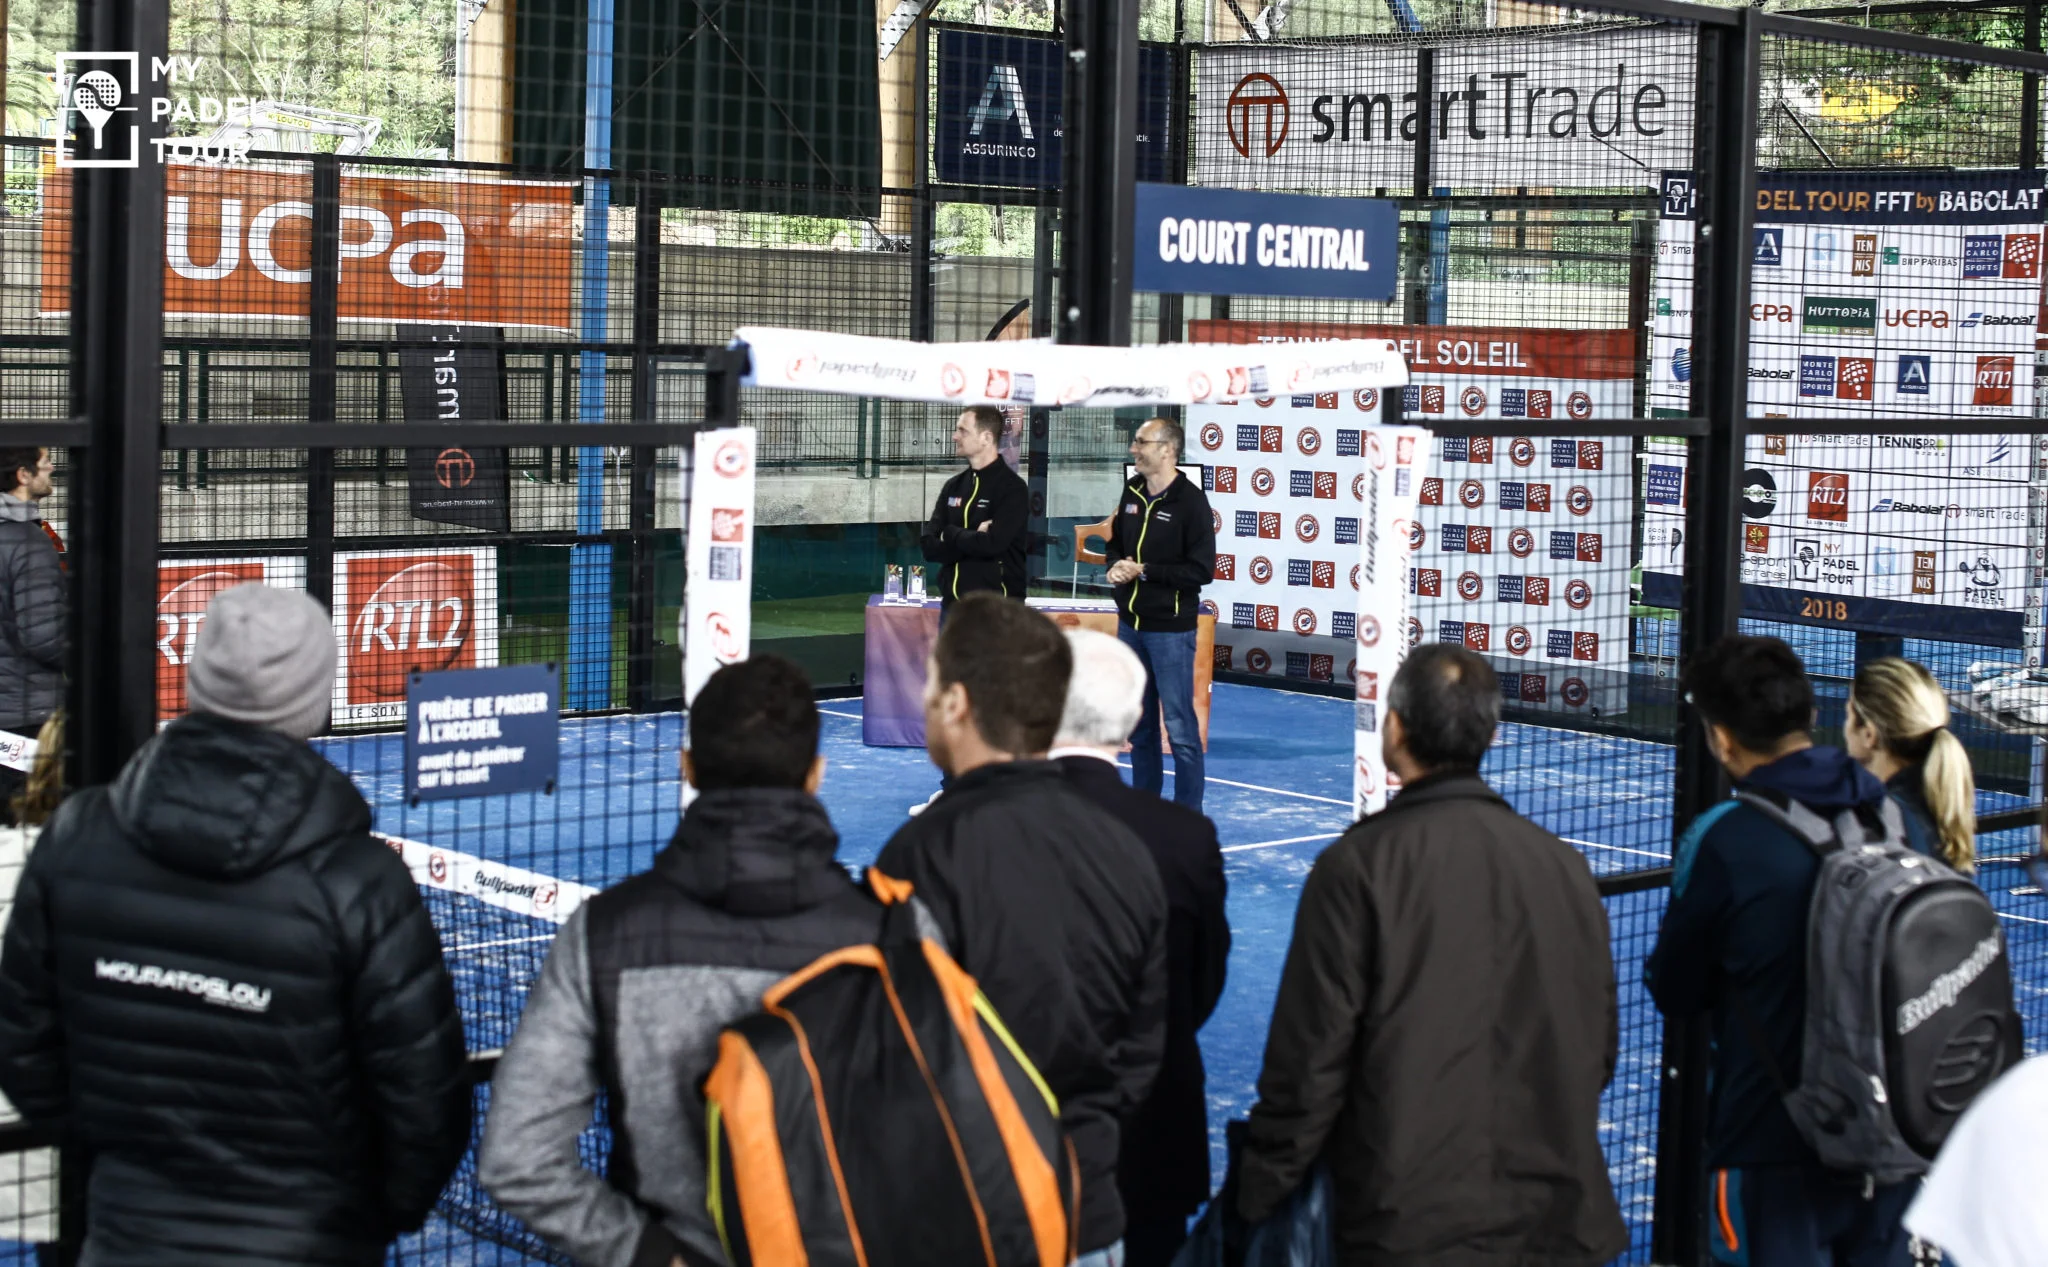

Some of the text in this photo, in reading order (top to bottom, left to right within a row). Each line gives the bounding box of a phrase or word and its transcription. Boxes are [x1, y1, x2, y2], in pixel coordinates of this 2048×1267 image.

[963, 143, 1036, 158] ASSURINCO
[1756, 189, 2043, 213] DEL TOUR FFT by BABOLAT
[1159, 217, 1370, 271] COURT CENTRAL
[1856, 240, 1873, 252] TEN
[1854, 259, 1871, 272] NIS
[1922, 258, 1958, 266] PARIBAS
[1436, 340, 1527, 367] SOLEIL
[1802, 361, 1833, 369] MONTE
[1801, 383, 1832, 391] SPORTS
[1650, 478, 1680, 486] CARLO
[1812, 486, 1845, 505] RTL2
[1822, 558, 1860, 572] PADEL
[1916, 556, 1934, 569] TEN
[1822, 572, 1853, 585] TOUR
[1915, 576, 1931, 589] NIS
[1965, 587, 2004, 600] PADEL
[1801, 597, 1848, 620] 2018
[359, 596, 463, 652] RTL2
[349, 706, 399, 718] LE SON
[474, 870, 537, 899] Bullpadel
